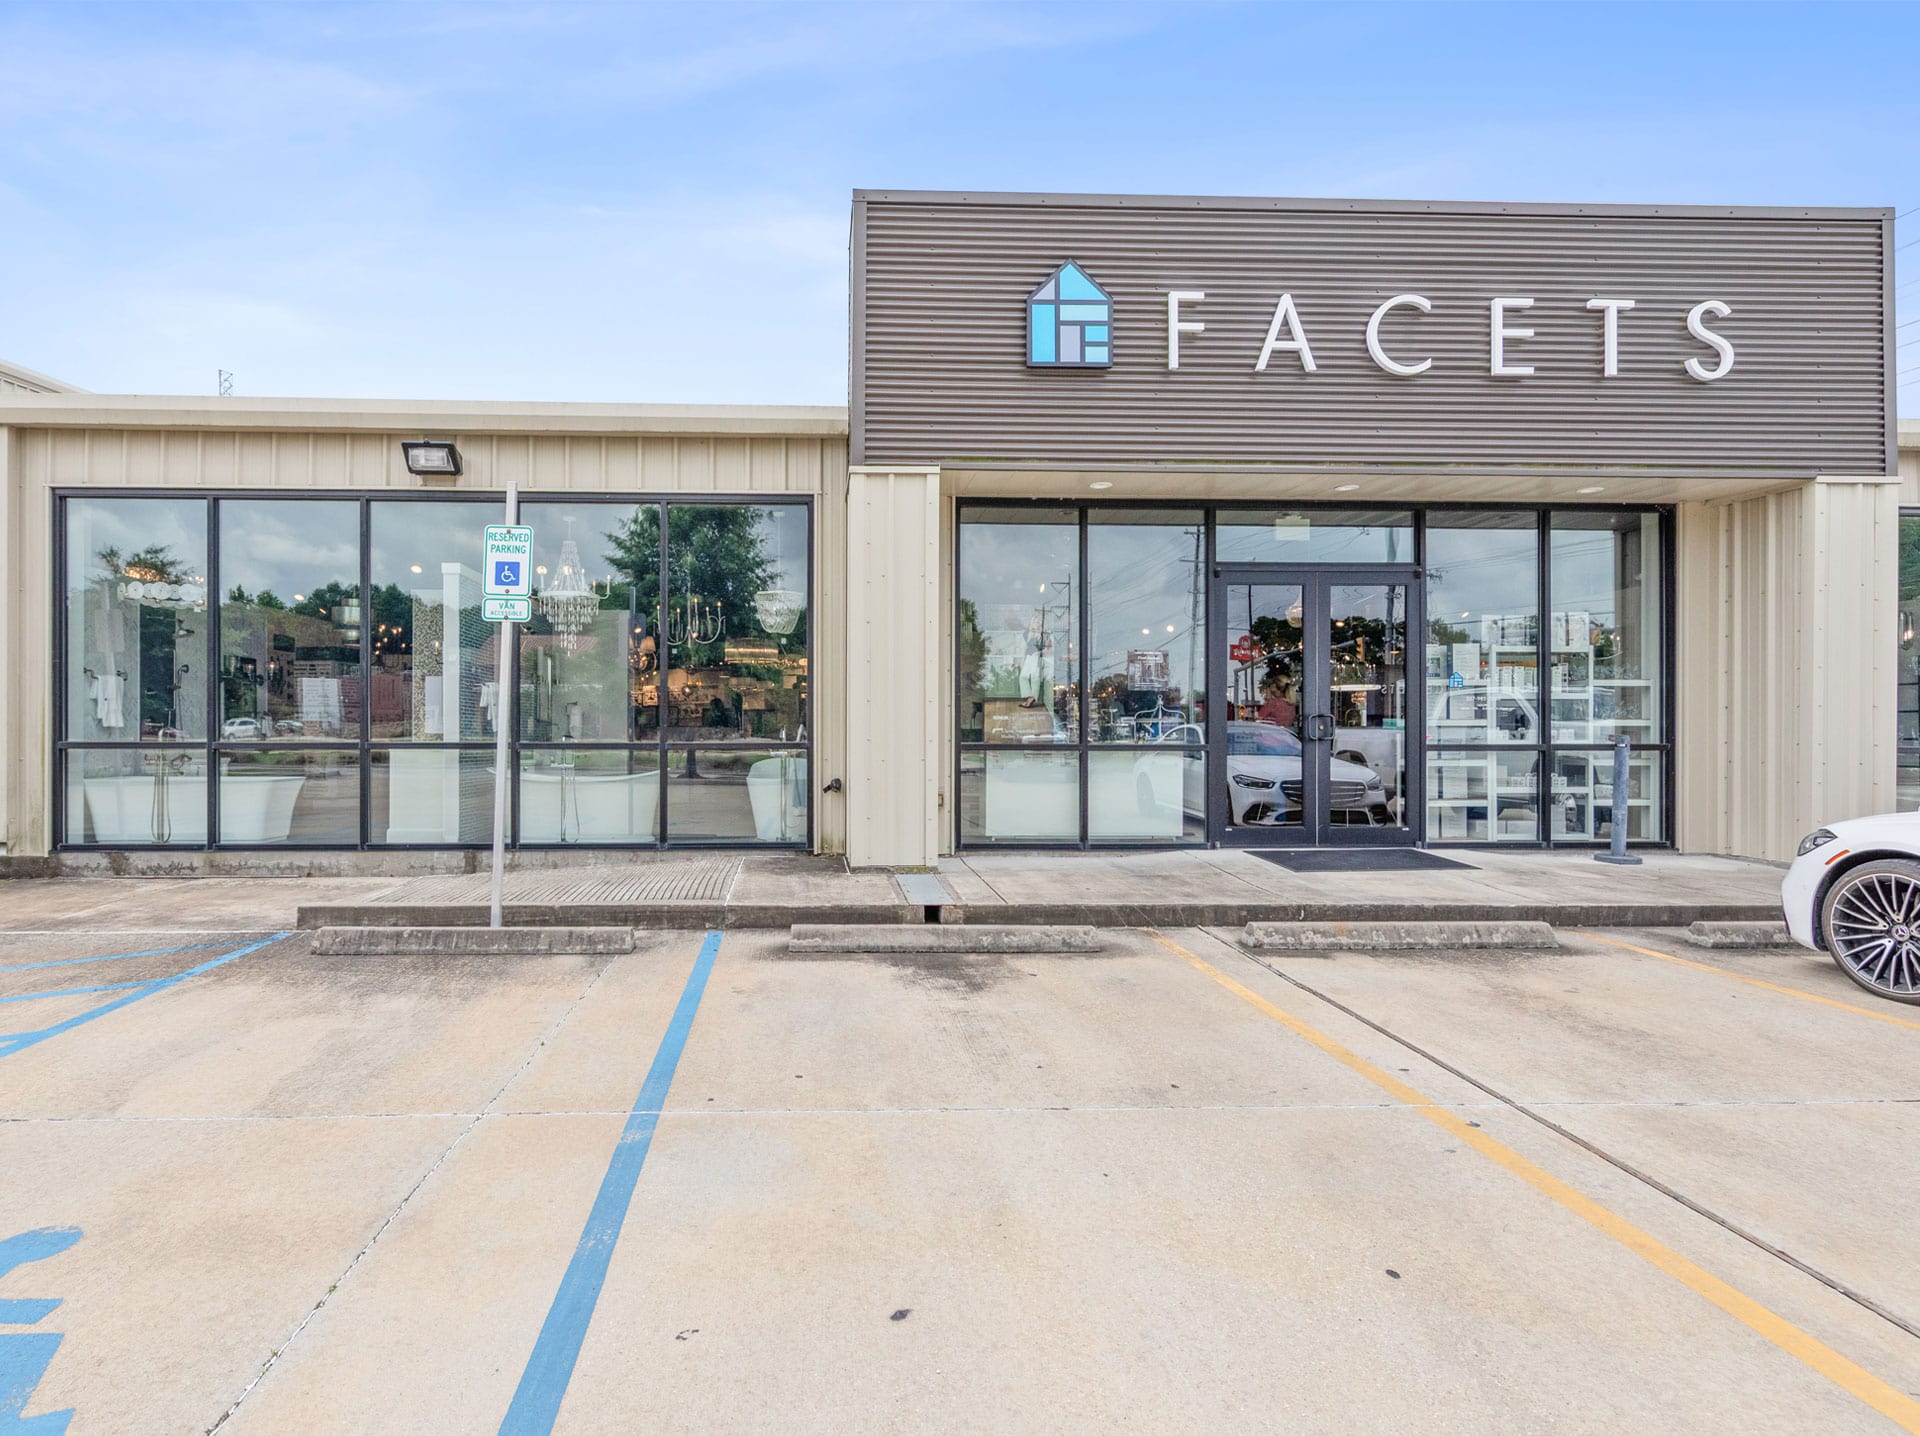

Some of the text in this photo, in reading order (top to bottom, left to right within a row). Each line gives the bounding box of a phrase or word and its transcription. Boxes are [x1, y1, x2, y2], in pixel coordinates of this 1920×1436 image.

[1167, 290, 1736, 381] FACETS
[488, 532, 529, 543] RESERVED
[490, 544, 527, 554] PARKING
[498, 602, 515, 610] VAN
